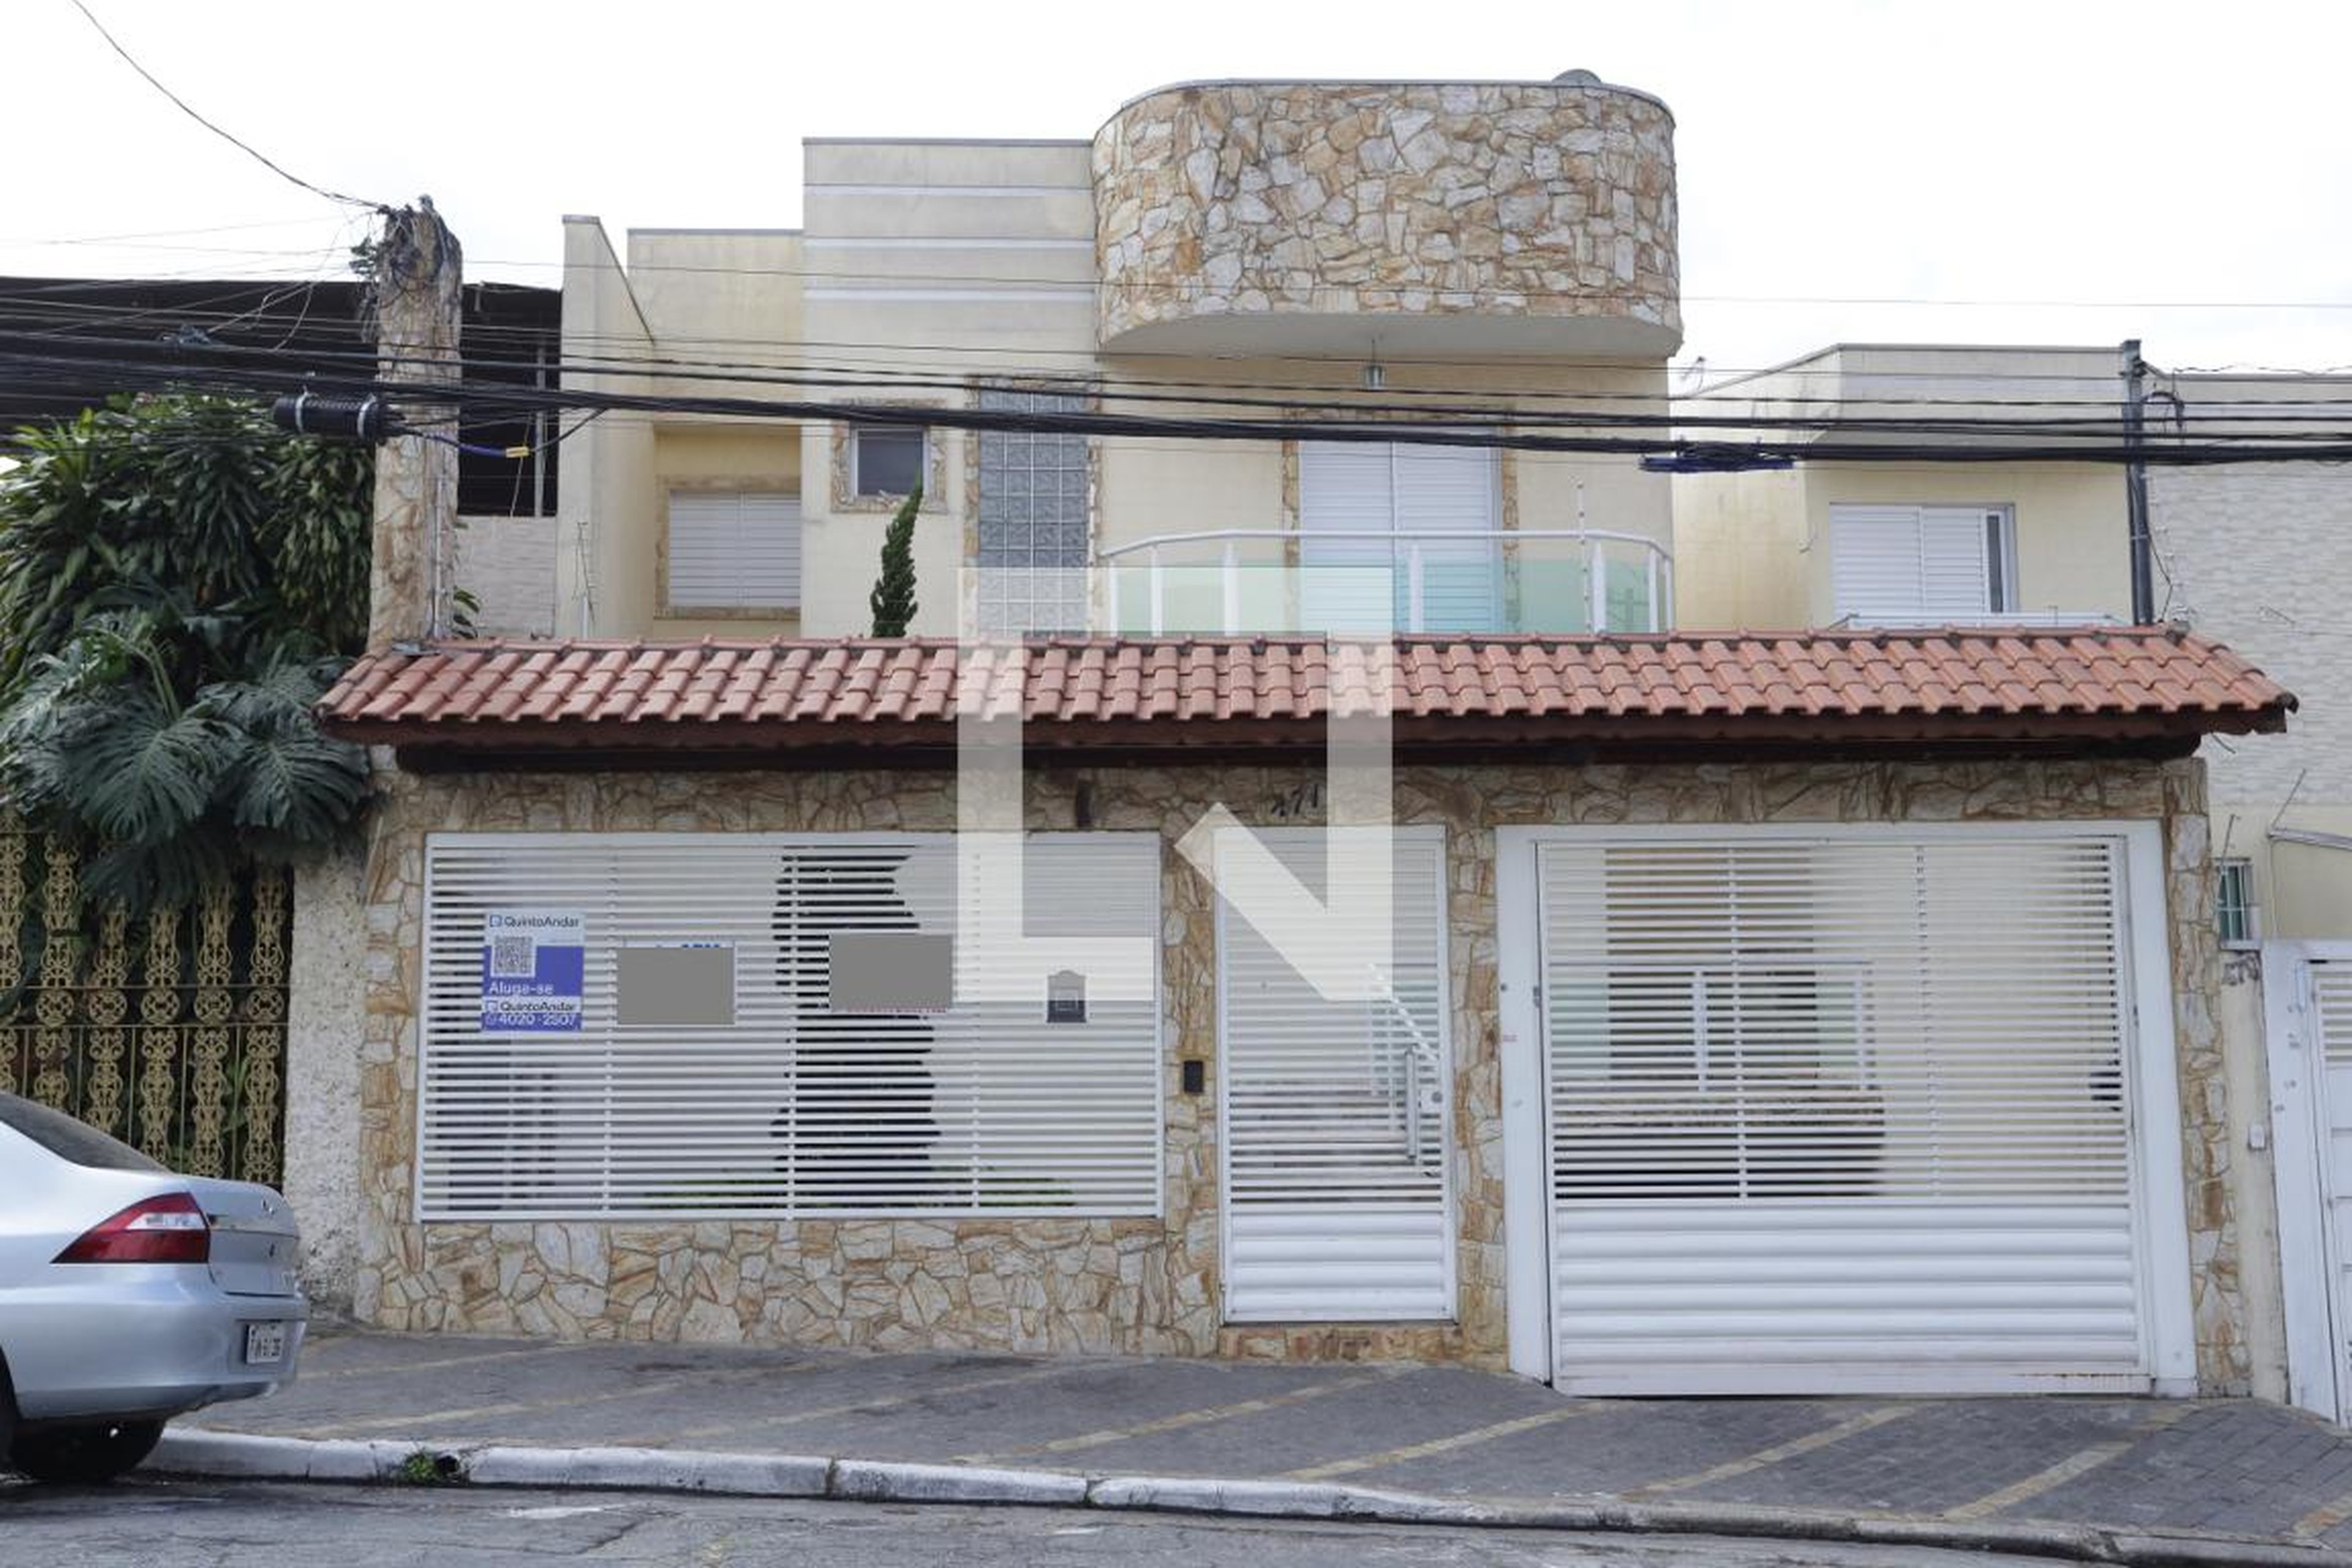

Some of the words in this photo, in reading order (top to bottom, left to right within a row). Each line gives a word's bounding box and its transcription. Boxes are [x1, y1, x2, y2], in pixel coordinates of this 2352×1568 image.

[504, 915, 579, 927] QuintoAndar
[489, 981, 554, 995] Aluga-se
[500, 1001, 574, 1011] QuintoAndar
